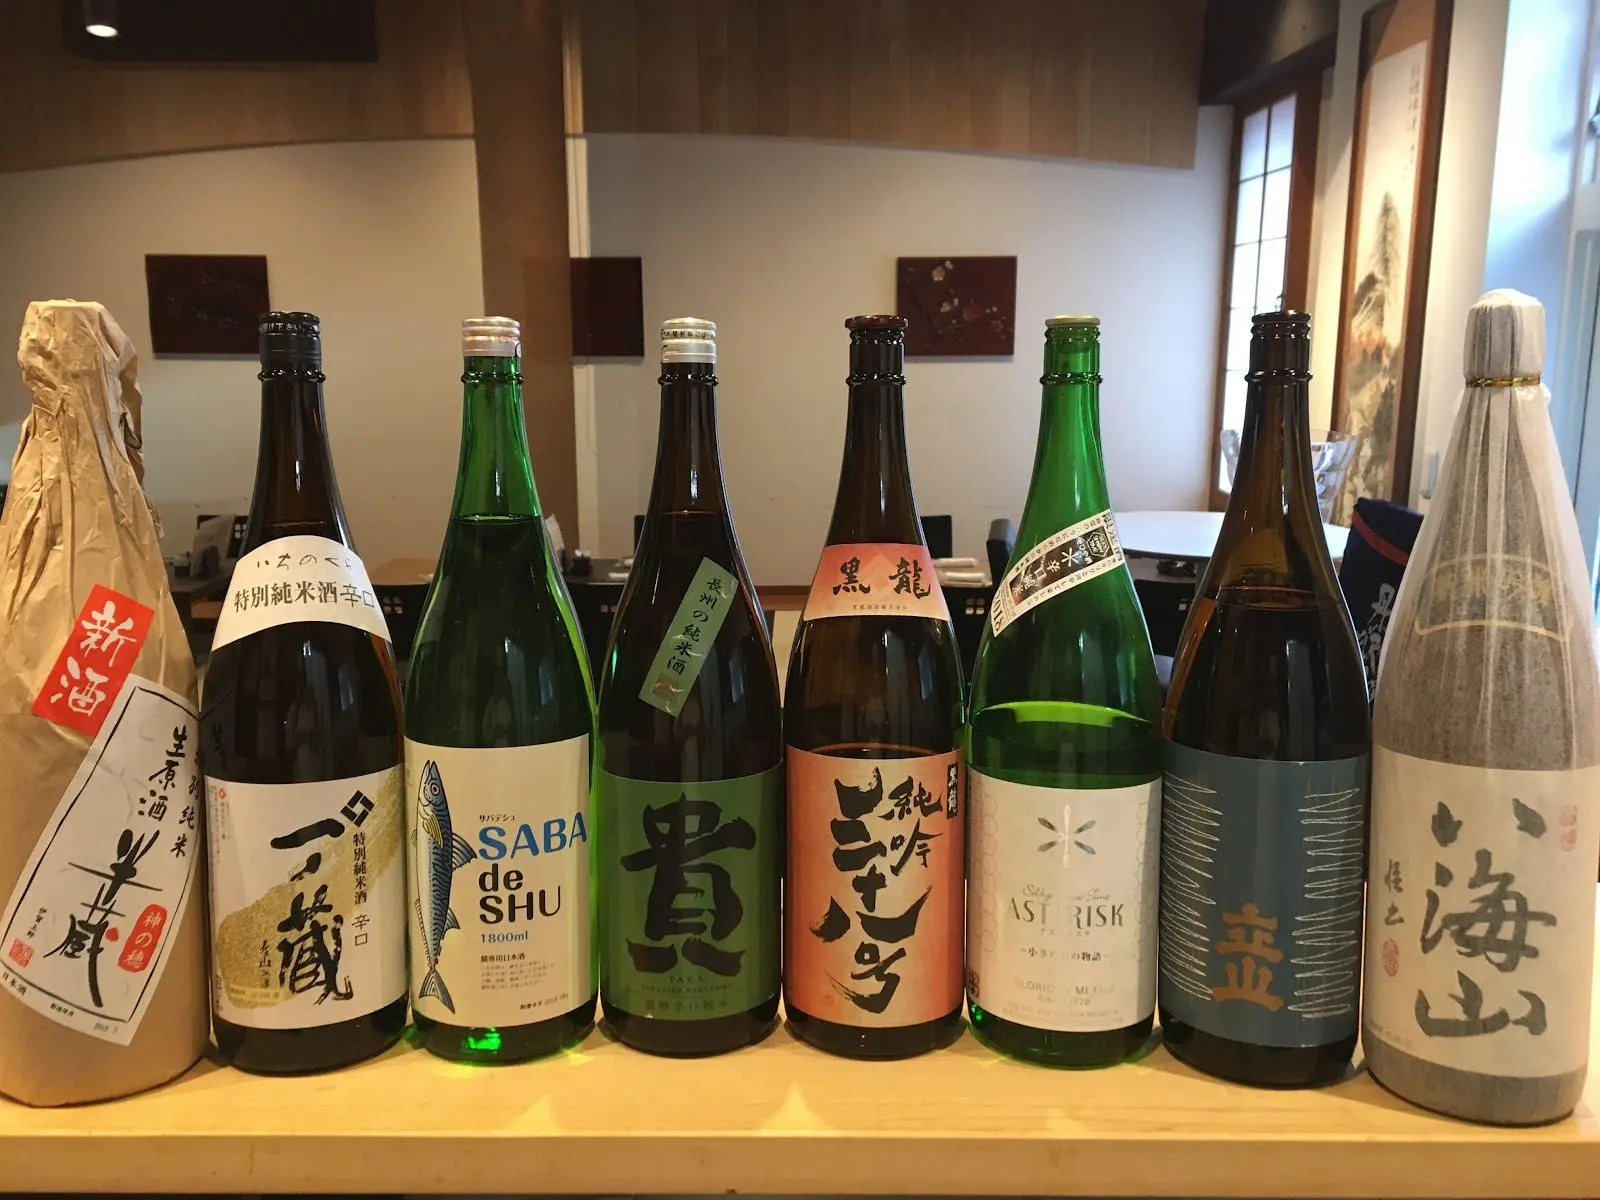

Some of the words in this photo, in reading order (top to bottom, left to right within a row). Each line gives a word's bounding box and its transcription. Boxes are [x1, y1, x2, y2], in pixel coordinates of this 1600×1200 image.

[234, 580, 374, 613] 特別純米酒辛口
[832, 556, 931, 599] 黒龍
[667, 577, 722, 675] 長州の純米酒
[51, 600, 136, 716] 新酒
[138, 725, 187, 821] 生原酒
[478, 811, 587, 860] SABA
[479, 814, 517, 823] サバデシュ
[878, 775, 943, 877] 純吟
[352, 832, 368, 905] 特別純米酒
[478, 863, 524, 892] de
[620, 791, 757, 977] 貴
[270, 818, 354, 1006] 一ノ蔵
[479, 885, 561, 925] SHU
[1006, 897, 1125, 930] ASTRISK
[1415, 798, 1558, 1038] 八海山
[352, 914, 370, 947] 辛口
[480, 930, 529, 943] 1800ml
